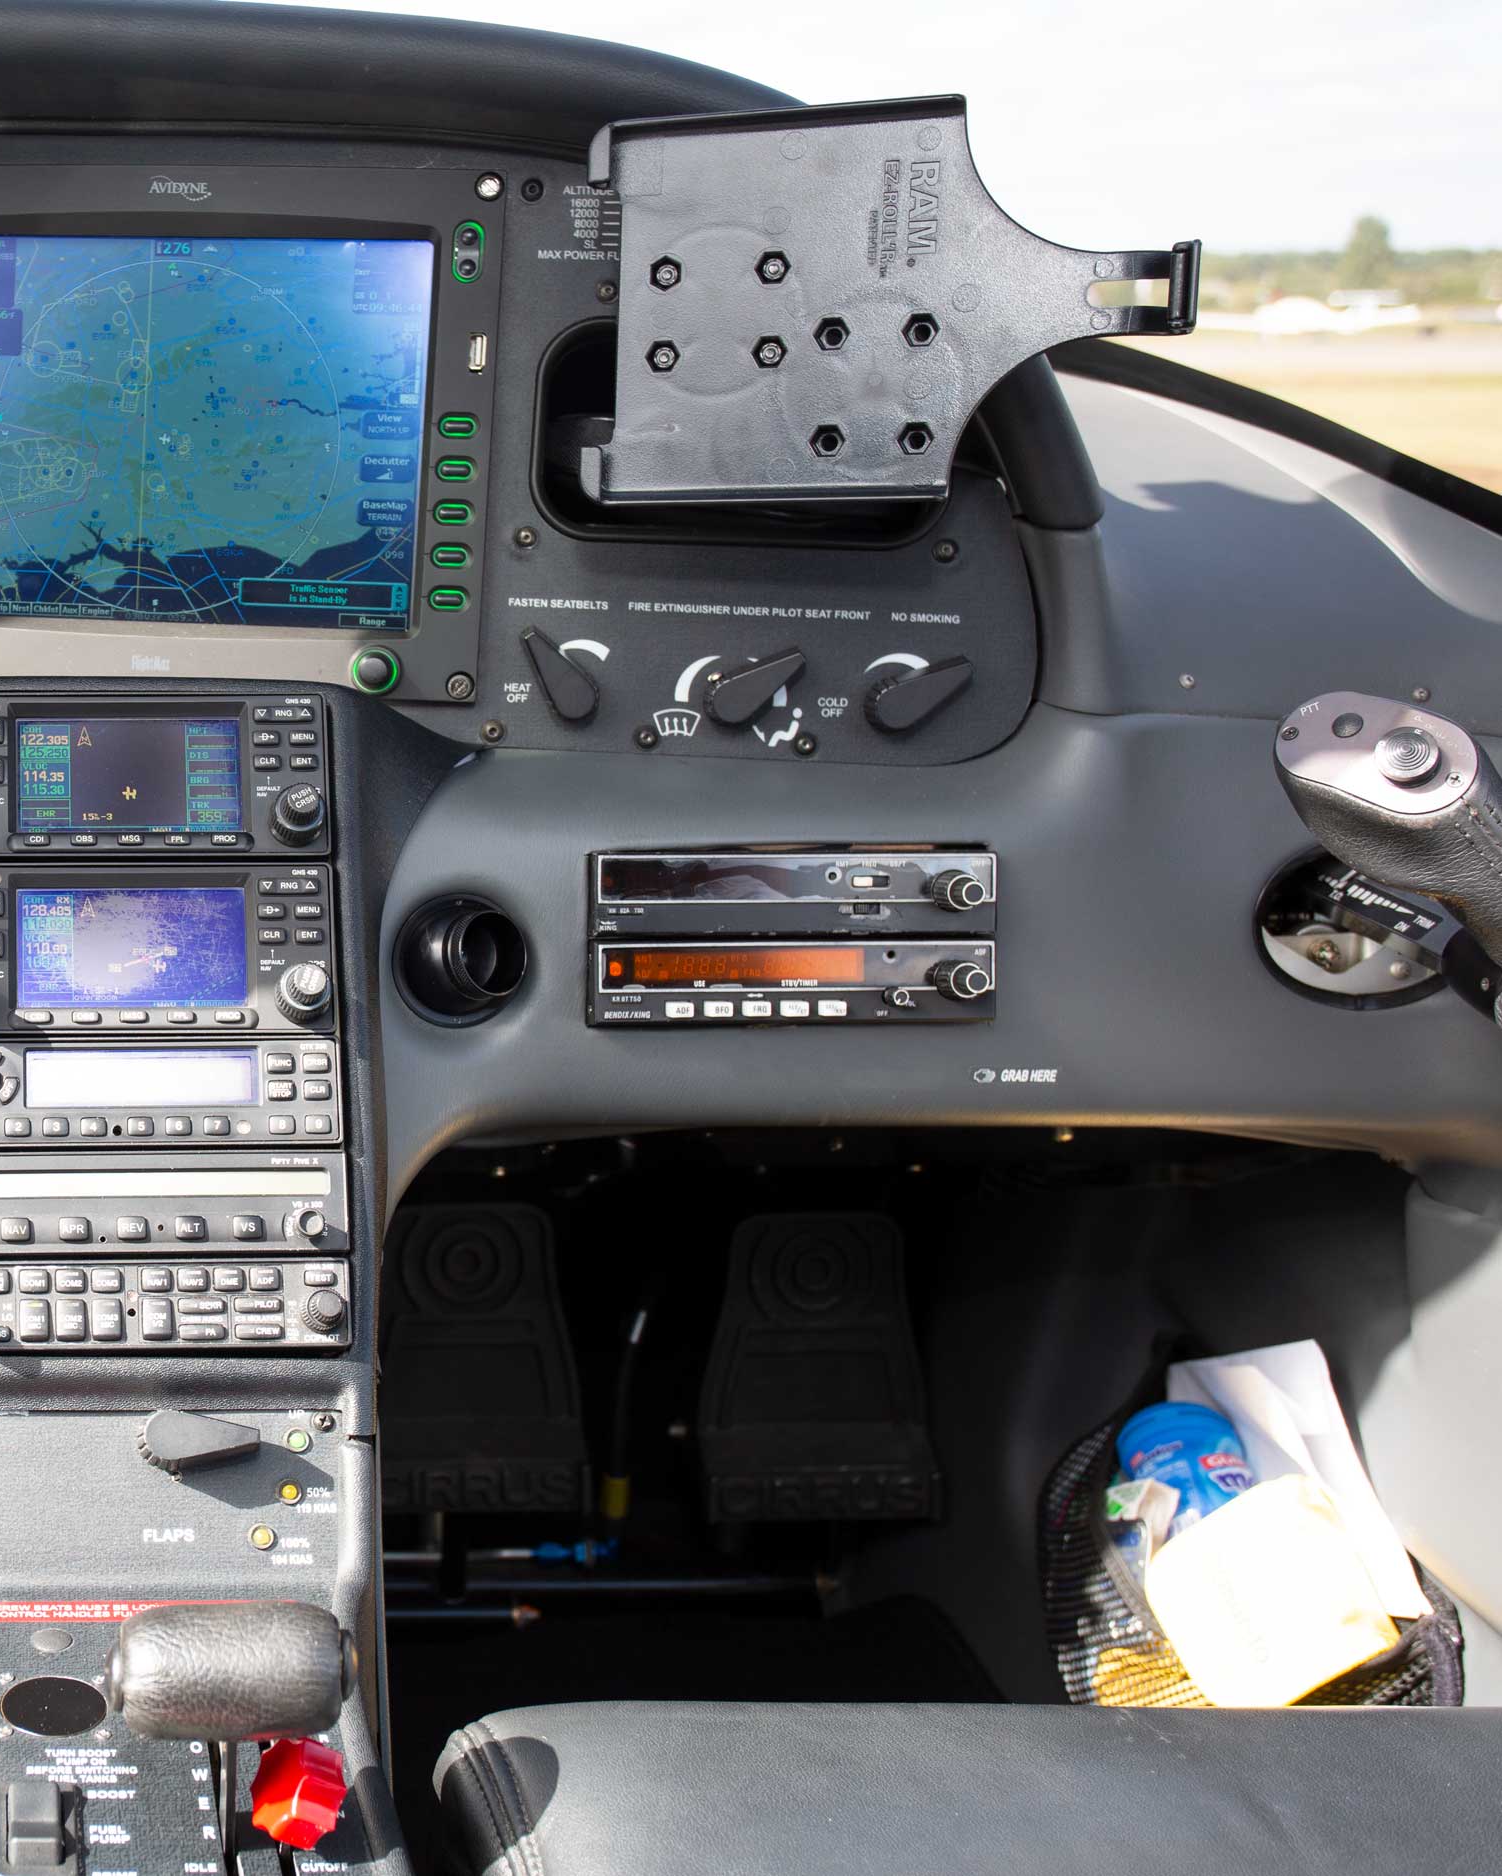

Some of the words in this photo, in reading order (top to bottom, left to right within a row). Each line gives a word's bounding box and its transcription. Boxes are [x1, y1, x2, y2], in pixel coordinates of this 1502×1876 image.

[149, 182, 208, 194] AVIDYNE
[571, 199, 599, 207] 16000
[570, 209, 598, 217] 12000
[907, 161, 940, 256] RAM
[575, 219, 598, 228] 8000
[573, 230, 597, 239] 4000
[164, 242, 190, 254] 276
[584, 240, 596, 249] SL
[538, 251, 561, 259] MAX
[564, 251, 604, 260] POWER
[377, 414, 401, 422] View
[364, 457, 410, 466] Declutter
[363, 501, 407, 511] BaseMap
[508, 598, 548, 608] FASTEN
[550, 599, 609, 610] SEATBELTS
[82, 606, 110, 616] Engine
[629, 601, 651, 611] FIRE
[654, 603, 730, 615] EXTINGUISHER
[733, 606, 769, 616] UNDER
[772, 608, 802, 618] PILOT
[805, 609, 831, 619] SEAT
[834, 610, 870, 620] FRONT
[359, 616, 386, 626] Range
[891, 612, 907, 622] NO
[910, 613, 960, 624] SMOKING
[504, 683, 531, 692] HEAT
[507, 693, 528, 702] OFF
[818, 697, 848, 707] COLD
[821, 708, 843, 717] OFF
[1300, 702, 1320, 716] PTT
[291, 787, 312, 801] PUSH
[295, 795, 316, 809] CRSR
[1001, 1069, 1029, 1082] GRAB
[1030, 1069, 1057, 1082] HERE
[5, 1225, 27, 1234] NAV
[62, 1224, 84, 1233] APR
[180, 1224, 199, 1232] ALT
[240, 1224, 256, 1232] VS
[306, 1488, 330, 1497] 50%
[313, 1504, 337, 1513] KIAS
[143, 1529, 194, 1542] FLAPS
[280, 1538, 310, 1548] 100%
[289, 1555, 313, 1565] KIAS
[45, 1749, 75, 1757] TURN
[78, 1749, 117, 1757] BOOST
[26, 1766, 72, 1774] BEFORE
[49, 1775, 77, 1783] FUEL
[80, 1775, 117, 1783] TANKS
[87, 1790, 136, 1799] BOOST
[89, 1825, 126, 1834] FUEL
[90, 1835, 130, 1843] PUMP
[185, 1863, 217, 1872] IDLE
[301, 1862, 348, 1872] CUTOFF
